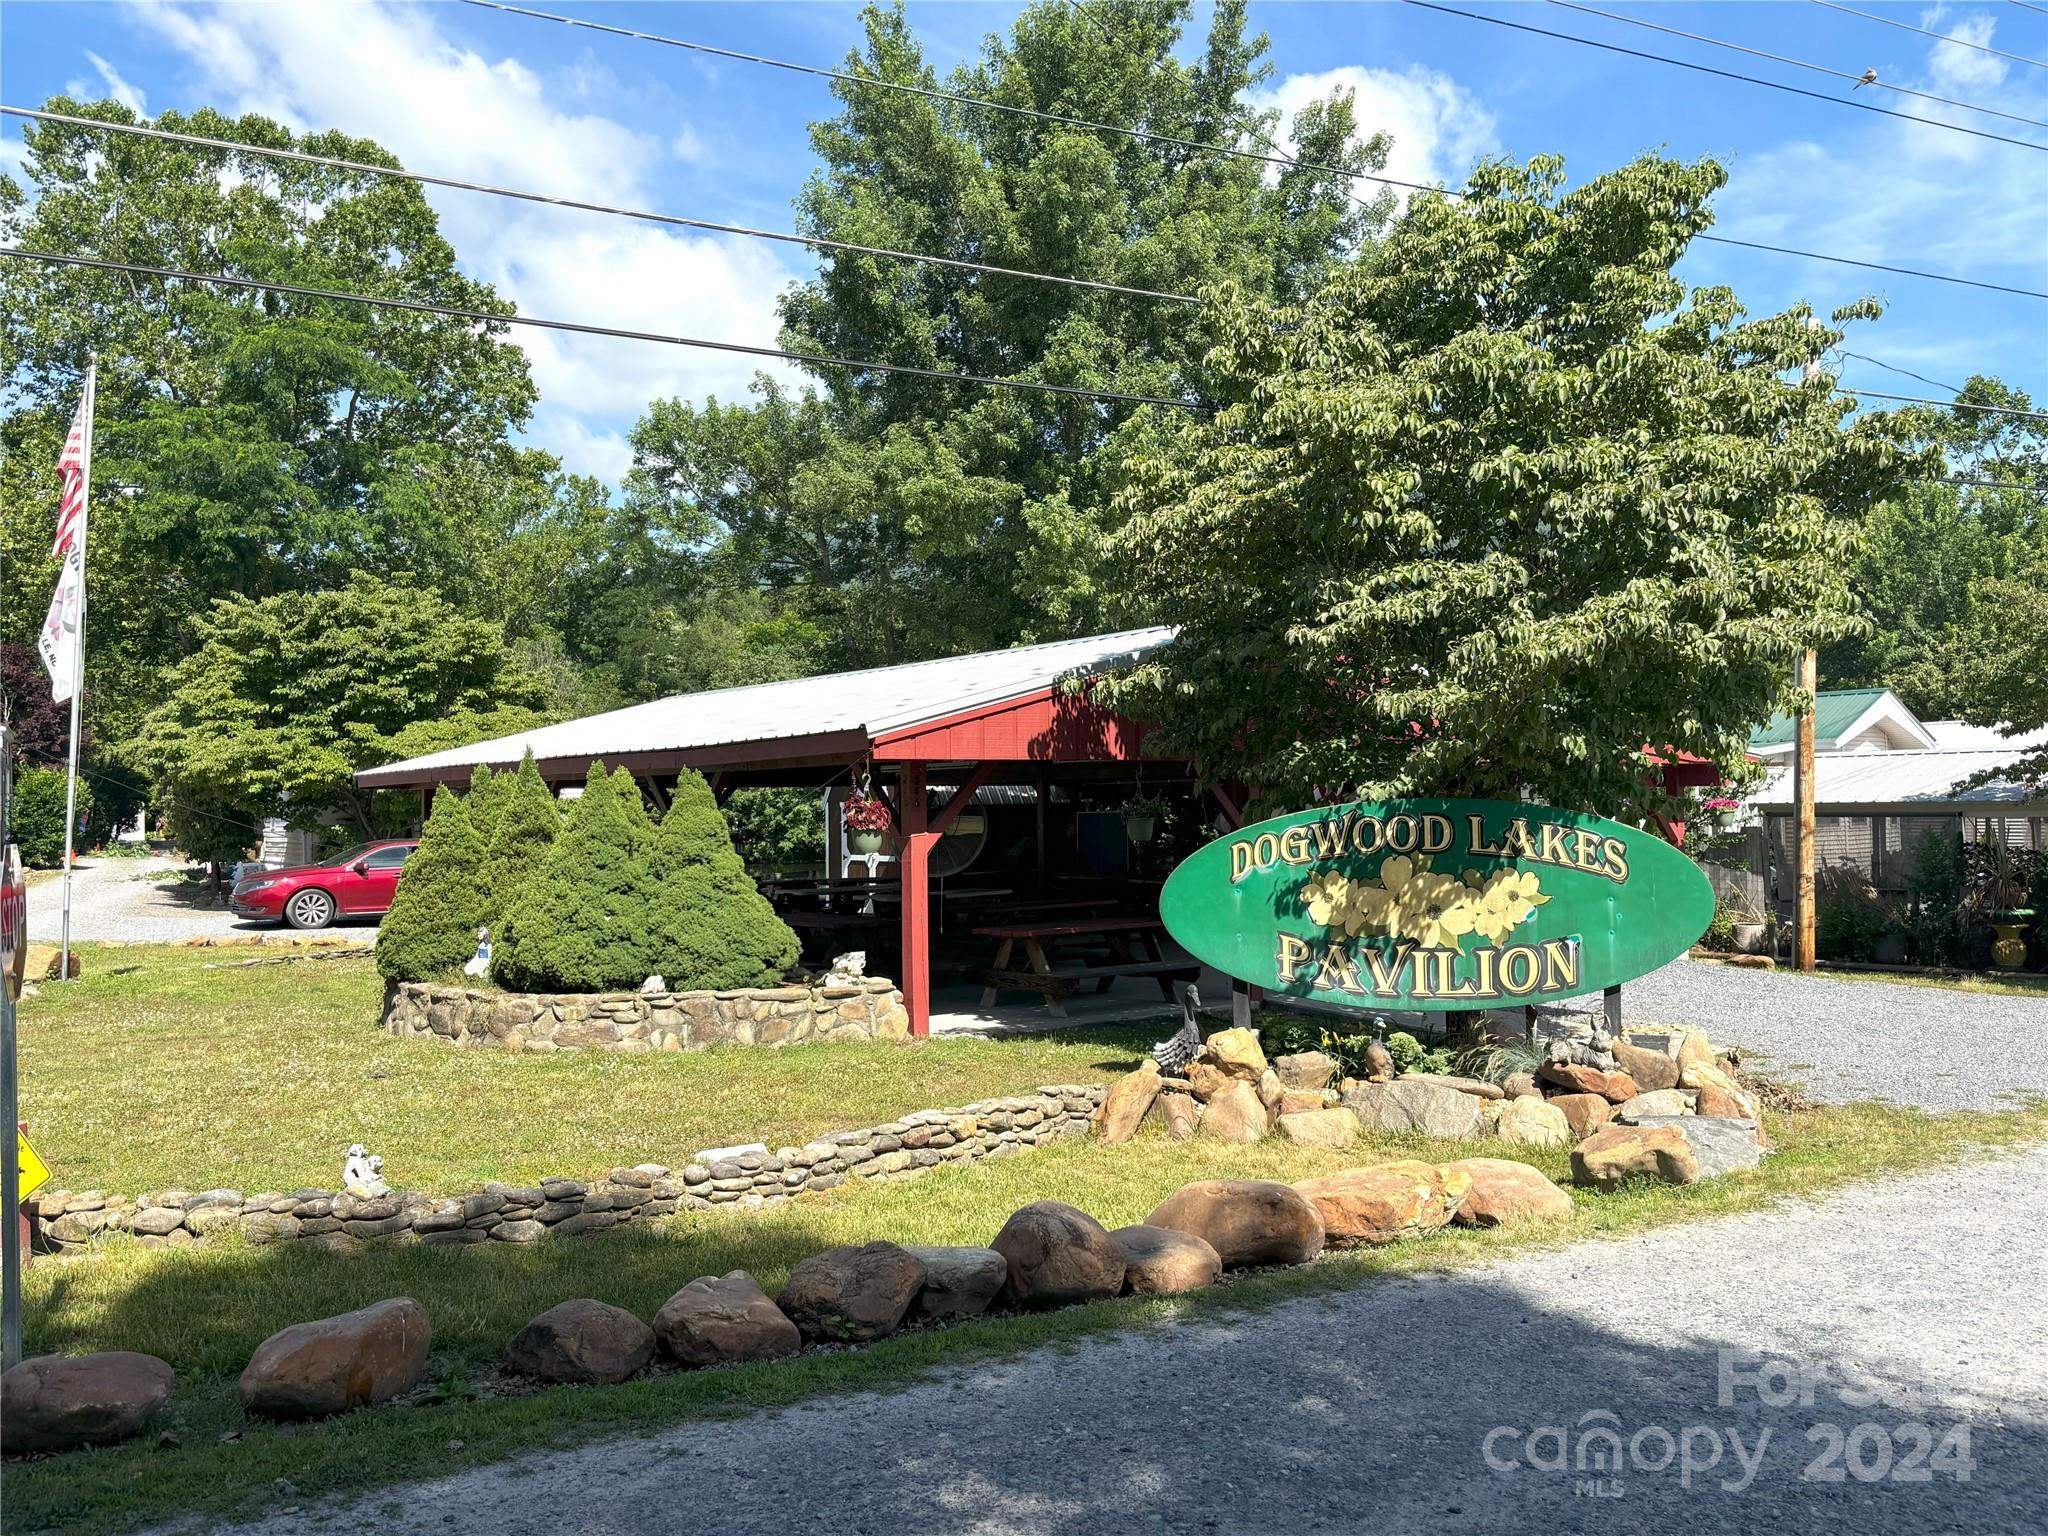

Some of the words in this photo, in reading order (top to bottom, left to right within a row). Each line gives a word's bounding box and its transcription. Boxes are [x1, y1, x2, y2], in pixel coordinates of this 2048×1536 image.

[1230, 809, 1454, 884] DOGWOOD
[1467, 812, 1630, 884] LAKES
[2, 895, 25, 950] STOP
[1276, 931, 1583, 998] PAVILION
